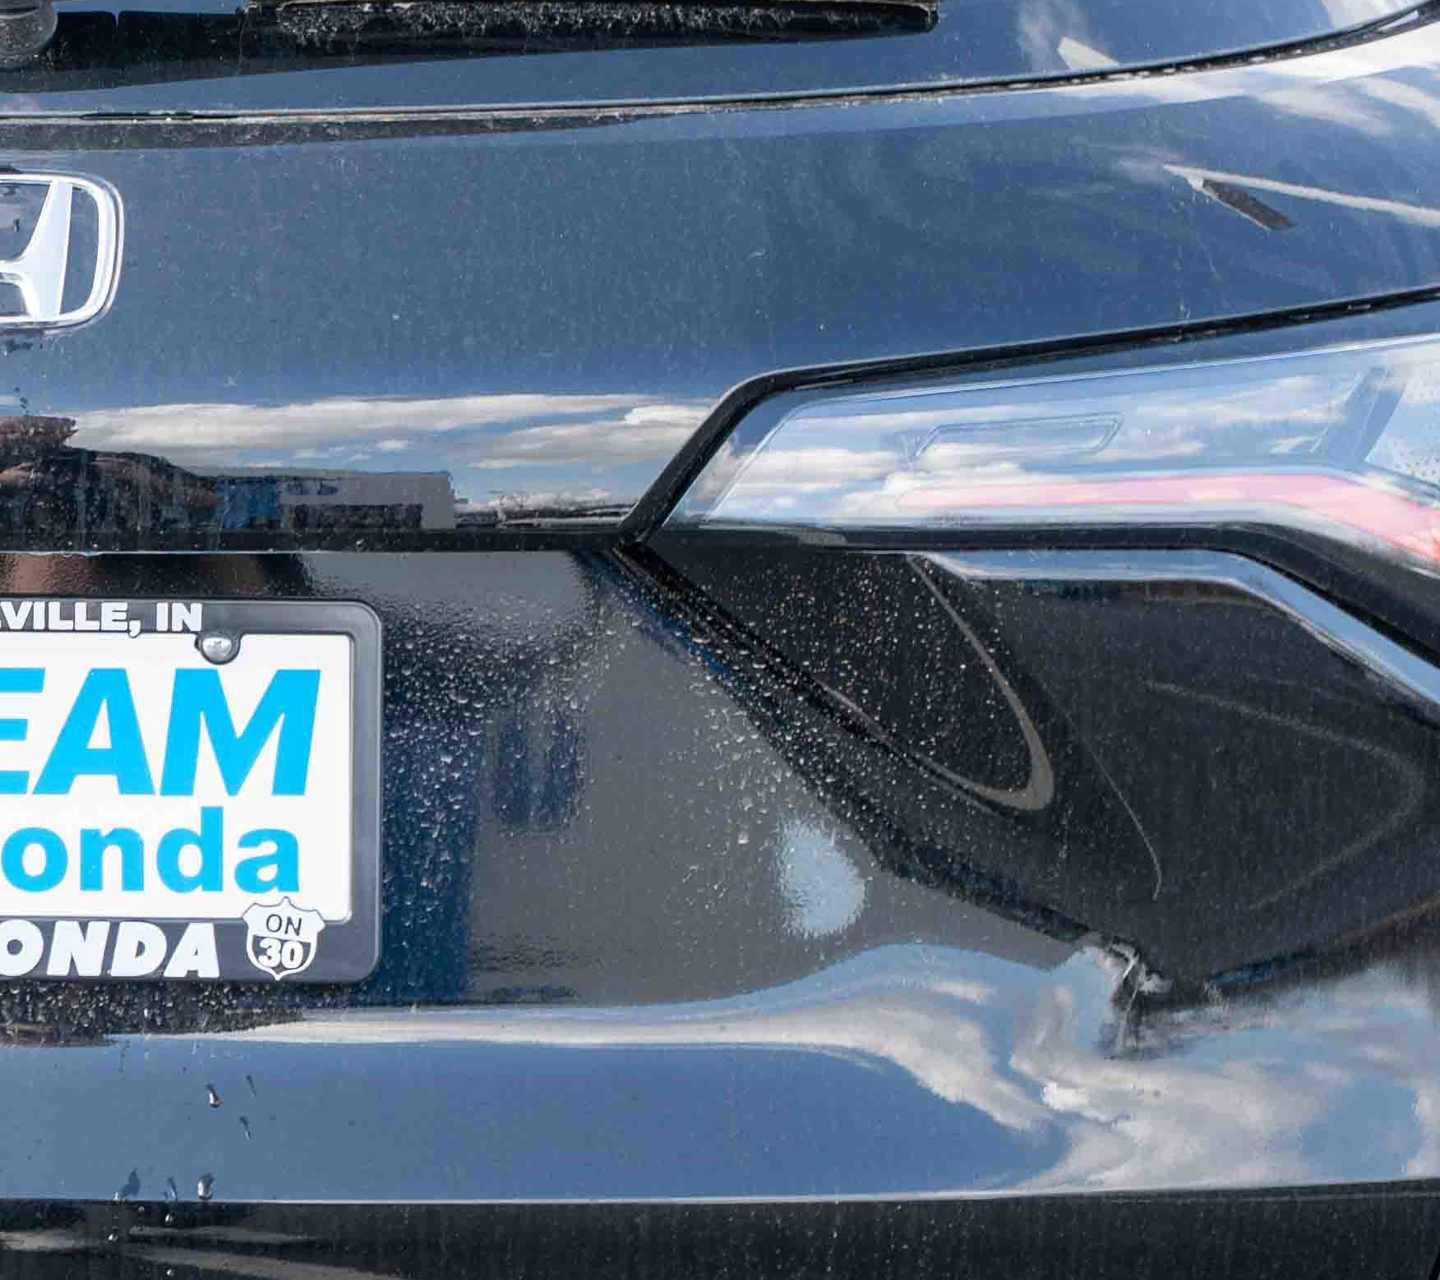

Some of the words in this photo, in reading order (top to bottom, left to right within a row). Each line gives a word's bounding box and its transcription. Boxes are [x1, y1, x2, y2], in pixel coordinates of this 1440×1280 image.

[156, 602, 203, 632] IN
[265, 913, 302, 936] ON
[257, 937, 304, 970] 30
